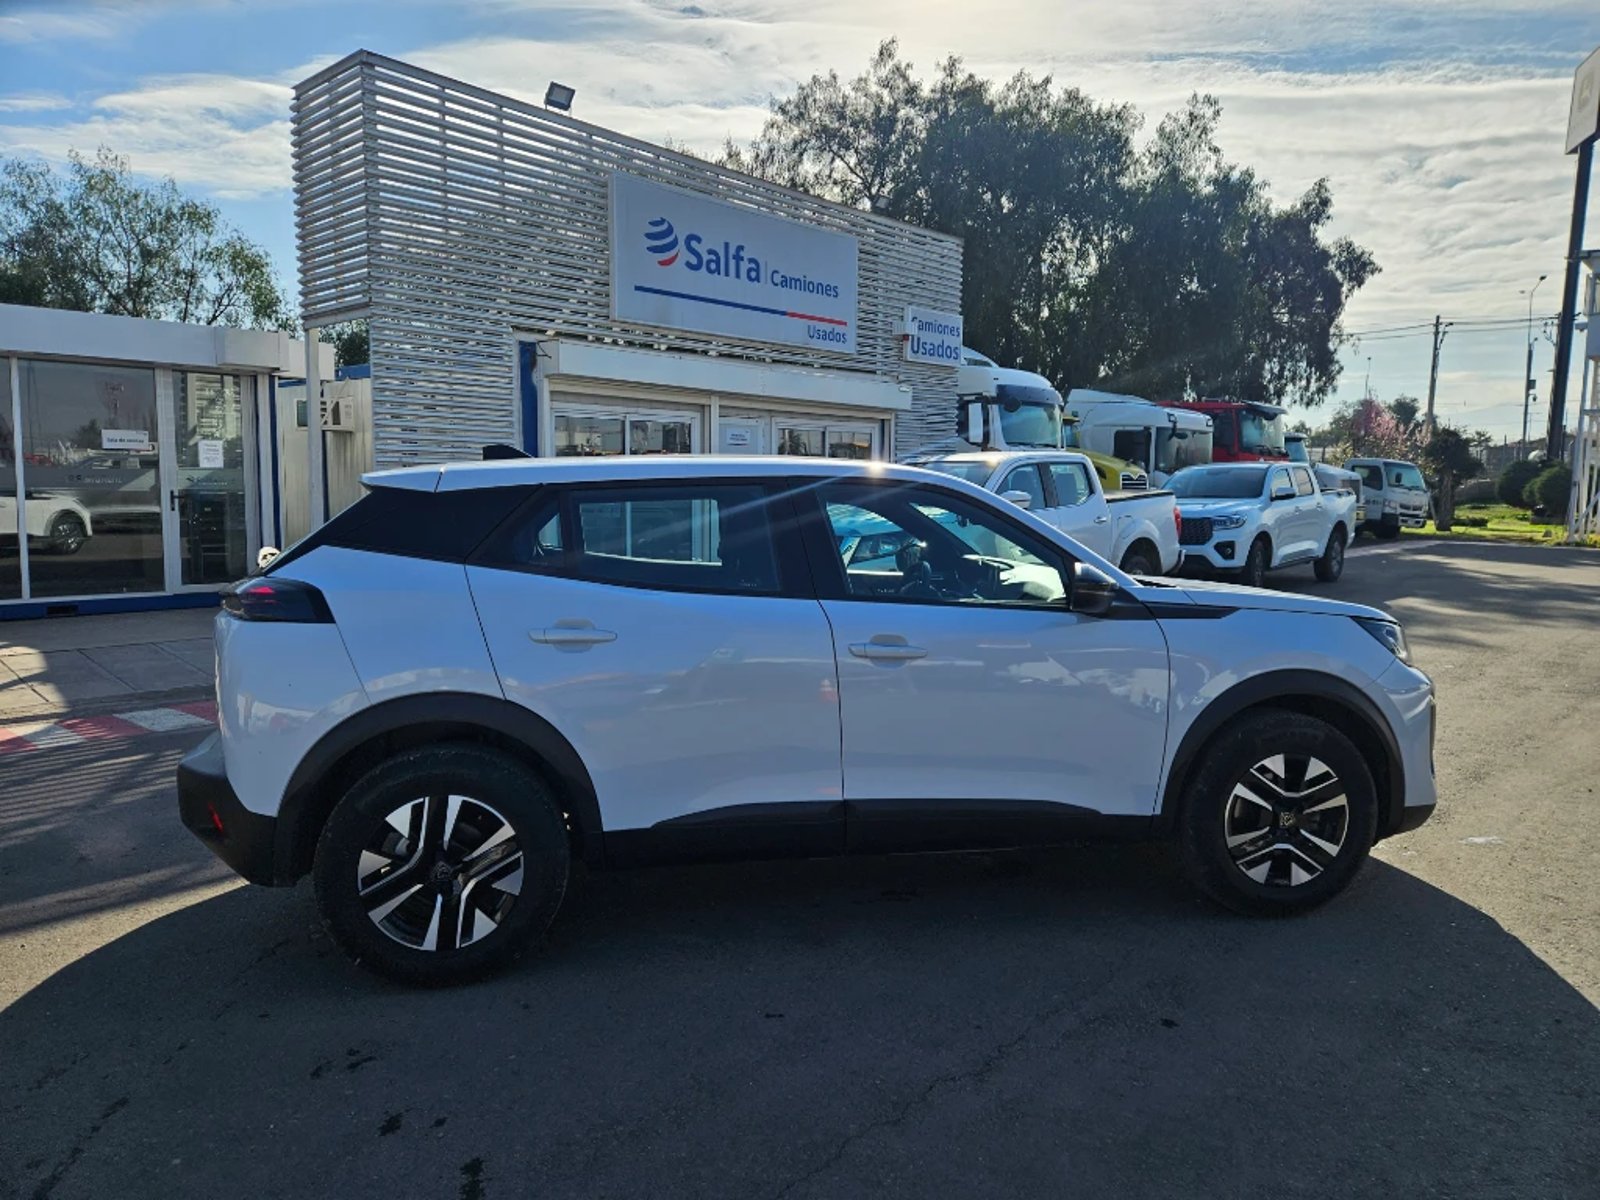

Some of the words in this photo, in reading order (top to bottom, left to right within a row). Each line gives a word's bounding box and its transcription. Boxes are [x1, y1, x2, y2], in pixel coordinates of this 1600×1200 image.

[684, 233, 761, 284] Salfa
[770, 269, 839, 299] Camiones
[807, 324, 848, 345] Usados
[910, 334, 959, 360] Usados
